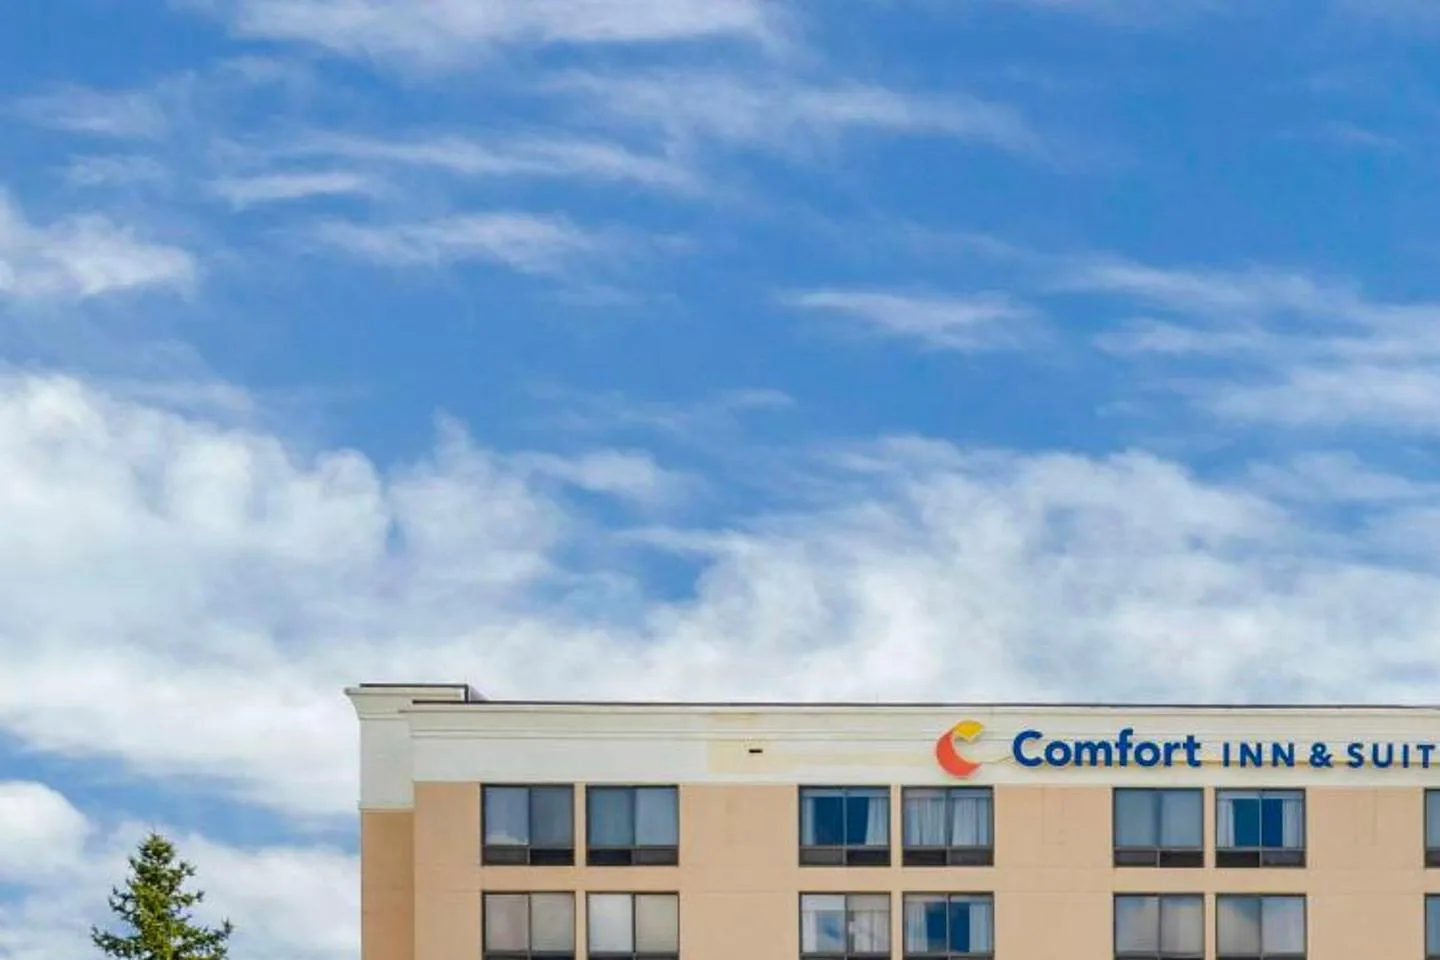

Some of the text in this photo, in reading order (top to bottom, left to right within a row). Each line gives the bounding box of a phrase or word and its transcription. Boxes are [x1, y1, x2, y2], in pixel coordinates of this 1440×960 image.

[1012, 728, 1202, 767] Comfort
[1222, 742, 1296, 768] INN
[1308, 742, 1334, 769] &
